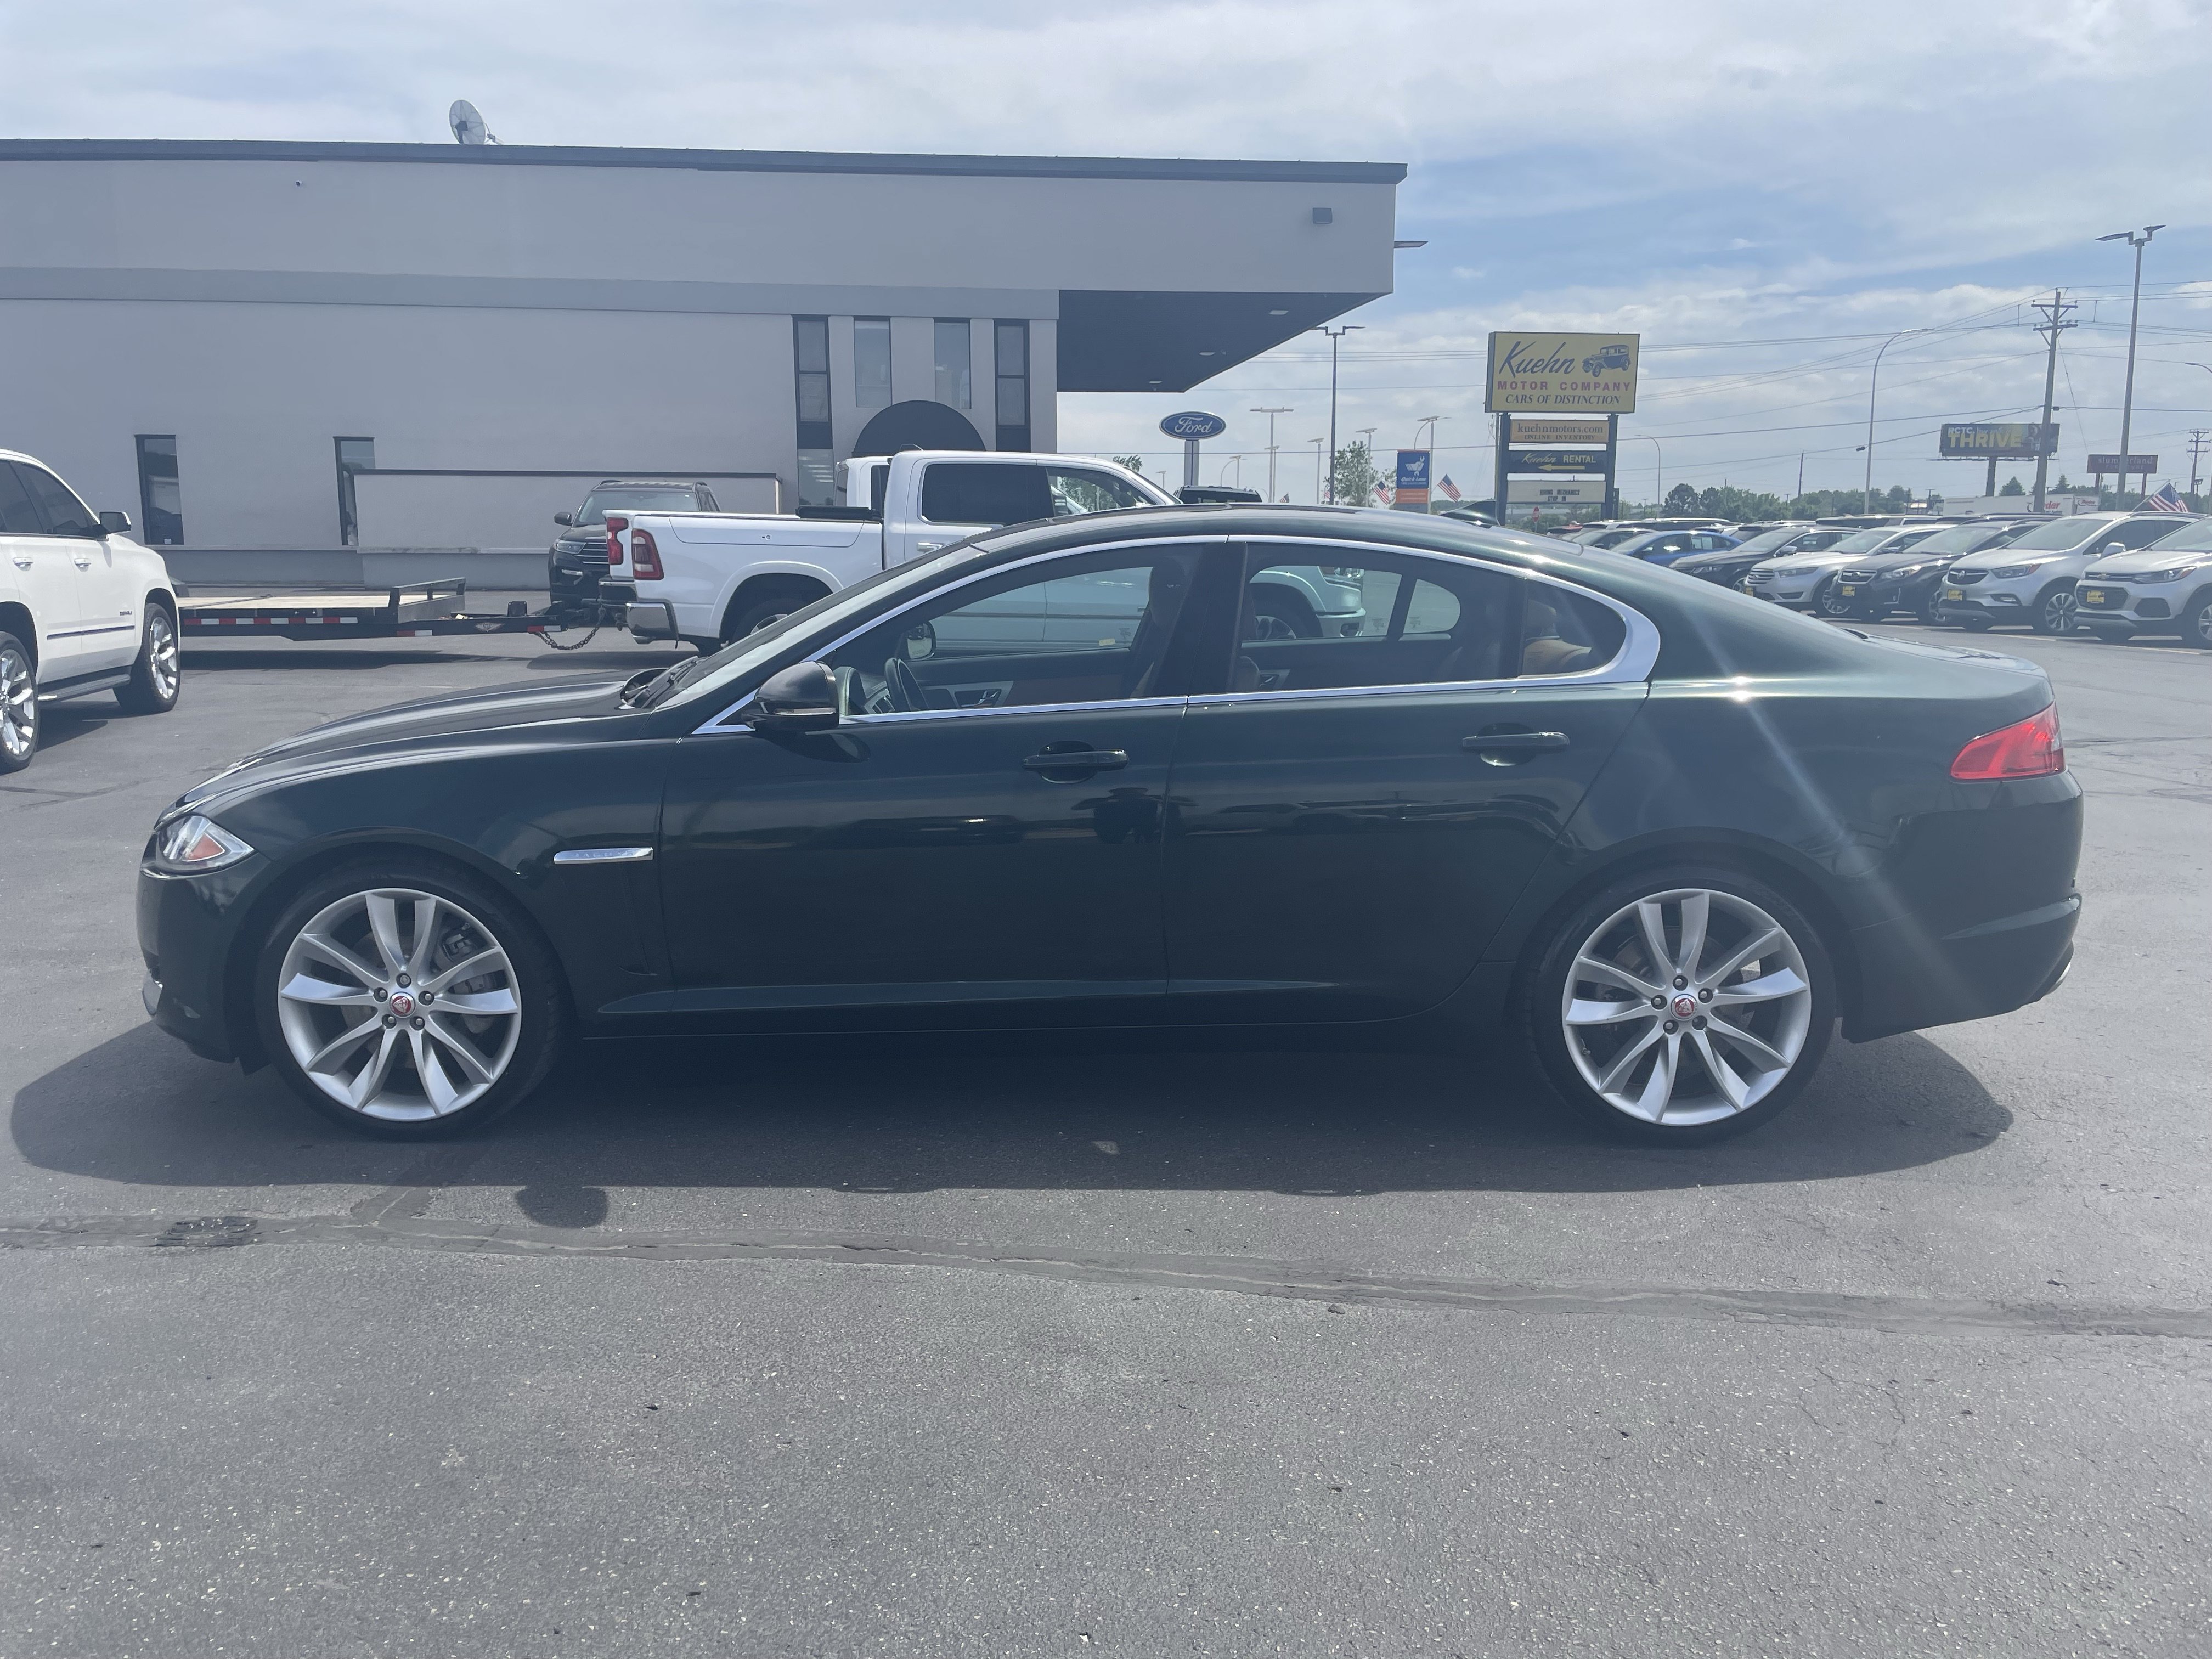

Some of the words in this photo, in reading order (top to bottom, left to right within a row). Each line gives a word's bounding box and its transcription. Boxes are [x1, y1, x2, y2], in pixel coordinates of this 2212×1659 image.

[1499, 341, 1575, 379] Kuehn
[1497, 381, 1548, 390] MOTOR
[1559, 381, 1632, 391] COMPANY
[1505, 394, 1533, 404] CARS
[1537, 394, 1551, 404] OF
[1554, 394, 1621, 405] DISTINCTION
[1174, 416, 1213, 433] Ford
[1517, 423, 1603, 433] kuehnmotors.com
[1521, 453, 1557, 464] Kuehn
[1563, 455, 1596, 464] RENTAL
